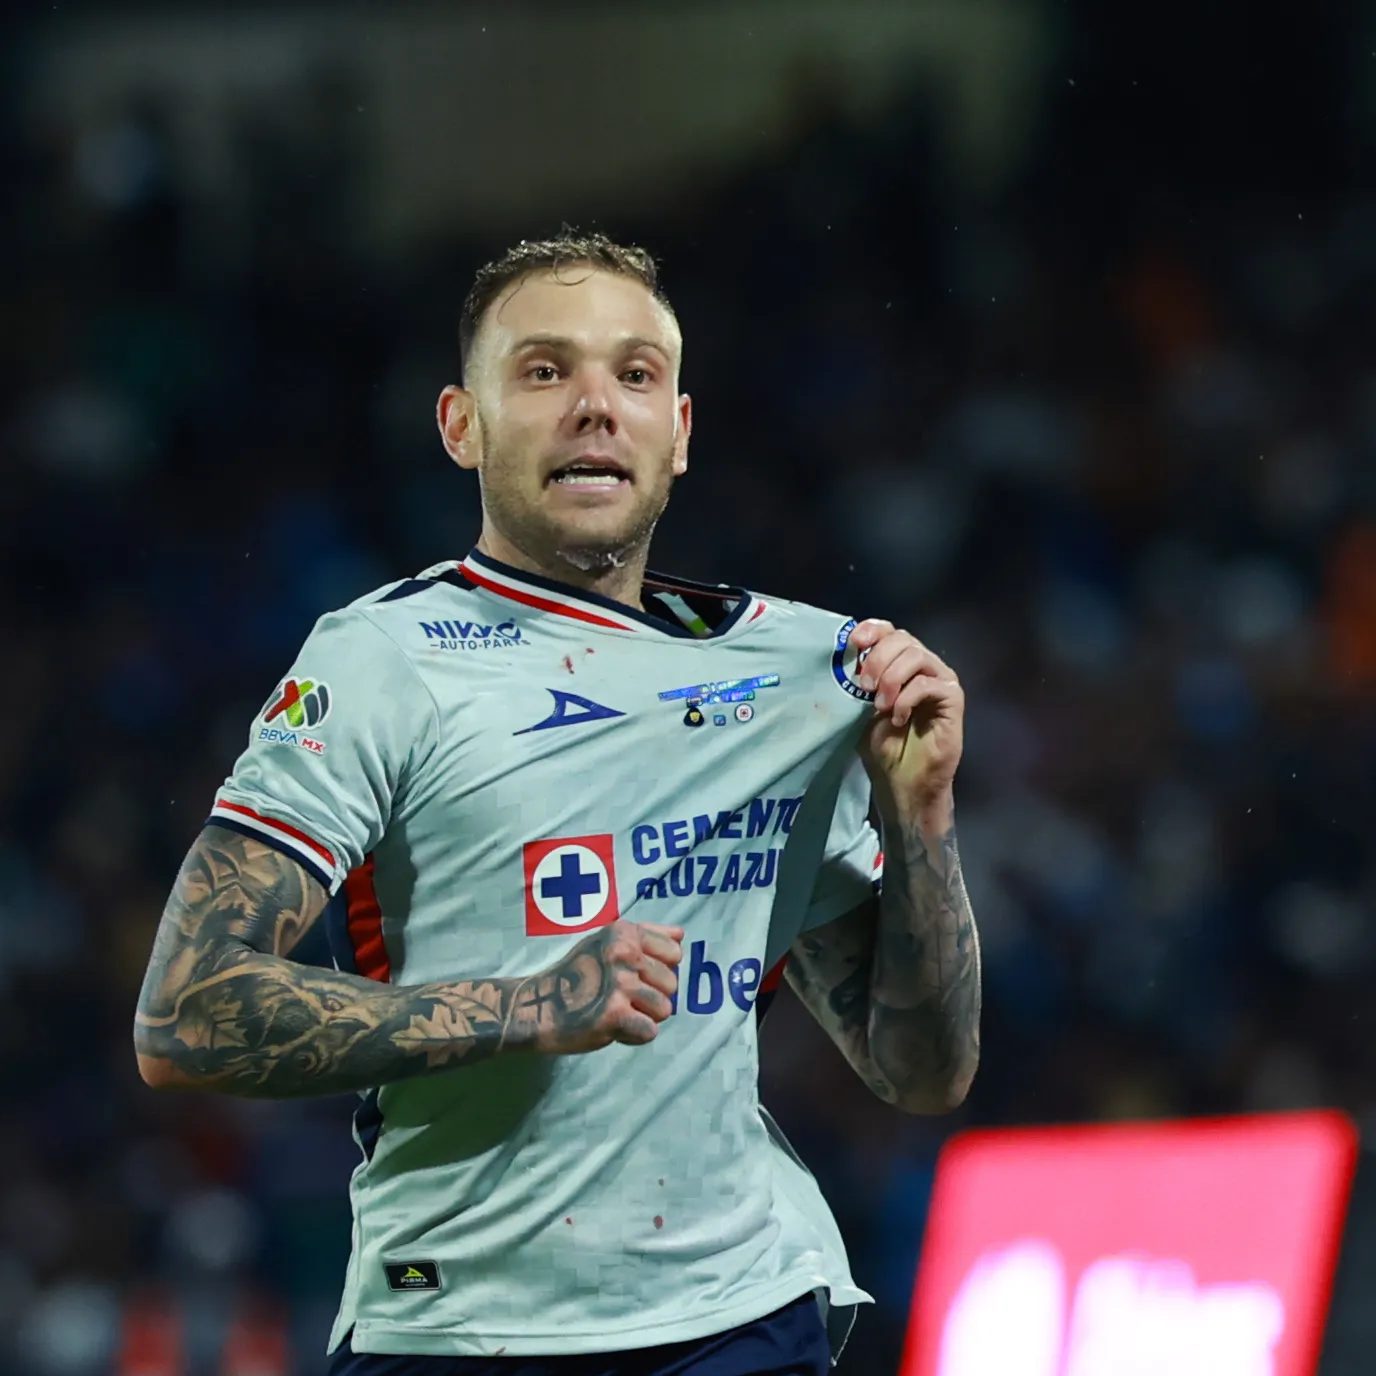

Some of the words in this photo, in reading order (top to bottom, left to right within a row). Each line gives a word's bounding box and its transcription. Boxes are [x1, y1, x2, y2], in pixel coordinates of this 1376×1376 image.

[258, 728, 298, 745] BBVA
[301, 738, 325, 753] MX
[719, 848, 785, 894] AZU
